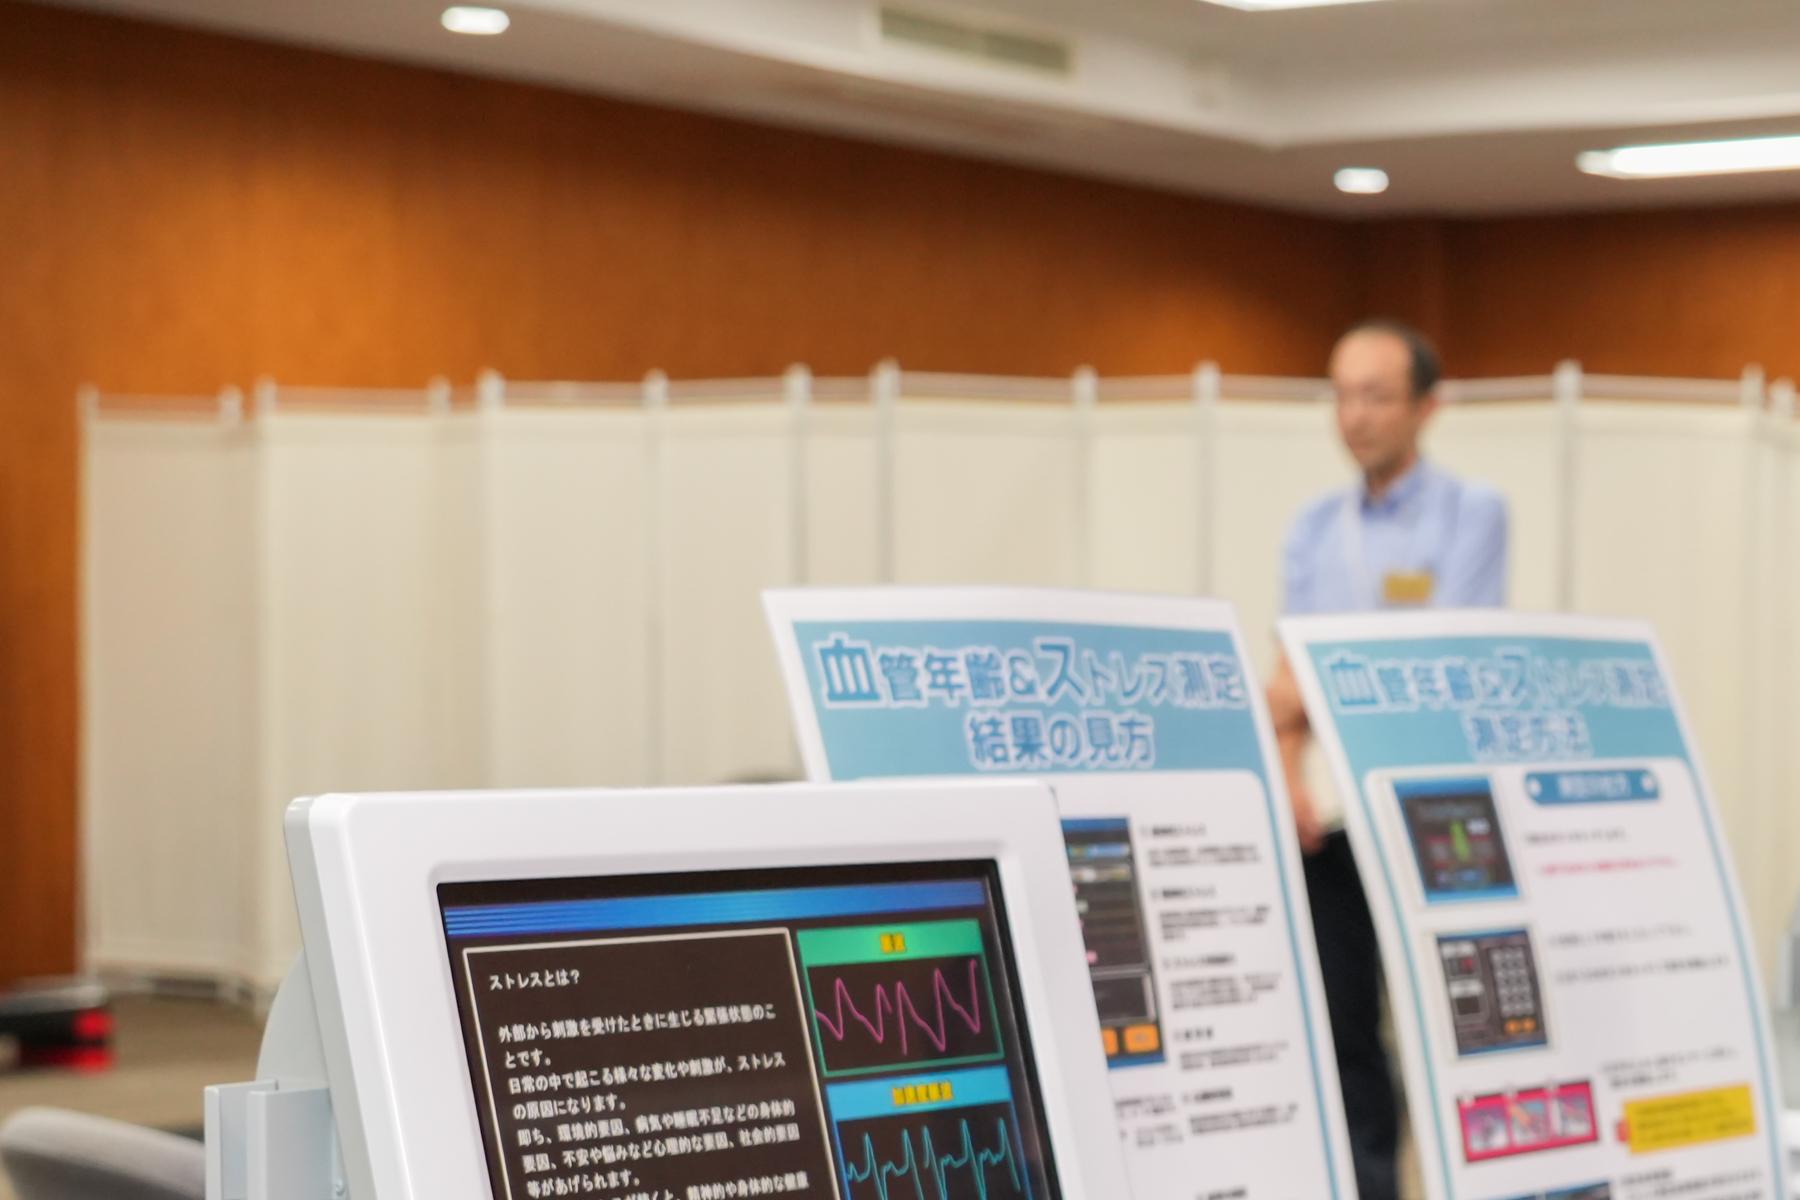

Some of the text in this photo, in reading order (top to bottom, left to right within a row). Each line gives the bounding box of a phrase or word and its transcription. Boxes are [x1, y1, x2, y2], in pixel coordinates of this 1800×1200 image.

[968, 712, 1156, 768] 結果の見方
[489, 969, 580, 991] ストレスとは？
[504, 1048, 552, 1069] とです。
[513, 1093, 626, 1120] の原因になります。
[527, 1169, 640, 1198] 等があげられます。
